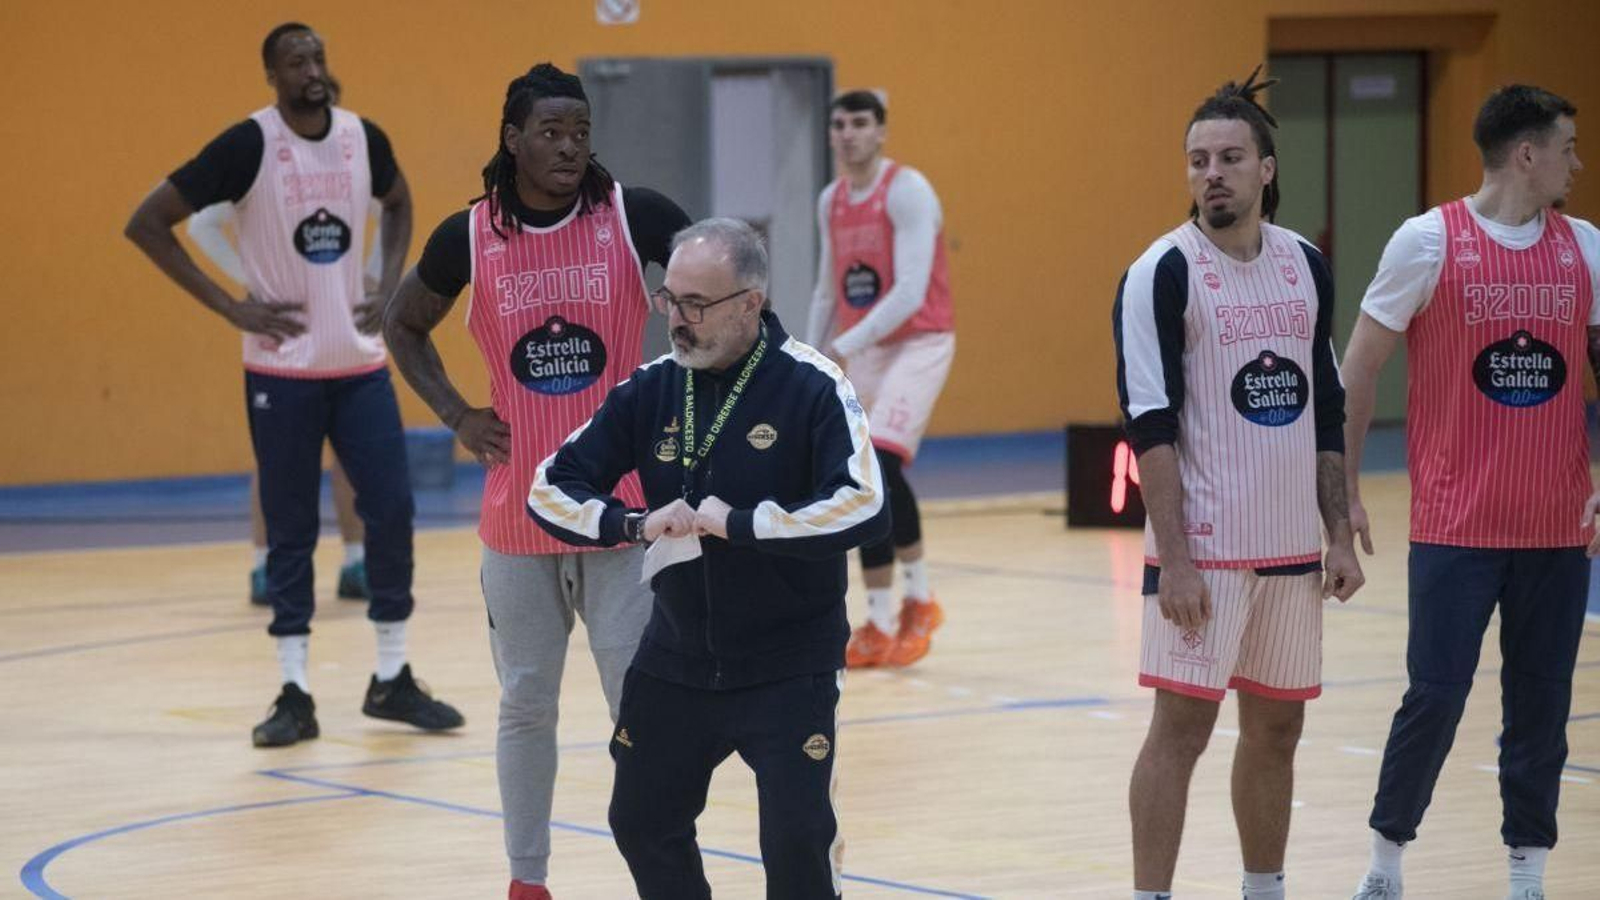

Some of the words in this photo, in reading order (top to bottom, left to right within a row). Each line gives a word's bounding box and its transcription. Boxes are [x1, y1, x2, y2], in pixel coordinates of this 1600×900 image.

[496, 263, 609, 316] 32005
[1464, 284, 1576, 325] 32005
[1216, 299, 1311, 346] 32005
[526, 338, 591, 358] Estrella
[529, 355, 590, 378] Galicia
[1490, 351, 1552, 369] Estrella
[1244, 370, 1298, 390] Estrella
[1491, 369, 1549, 388] Galicia
[697, 433, 715, 457] CLUB
[711, 392, 738, 434] OURENSE
[733, 340, 768, 394] BALONCESTO
[1248, 387, 1298, 409] Galicia
